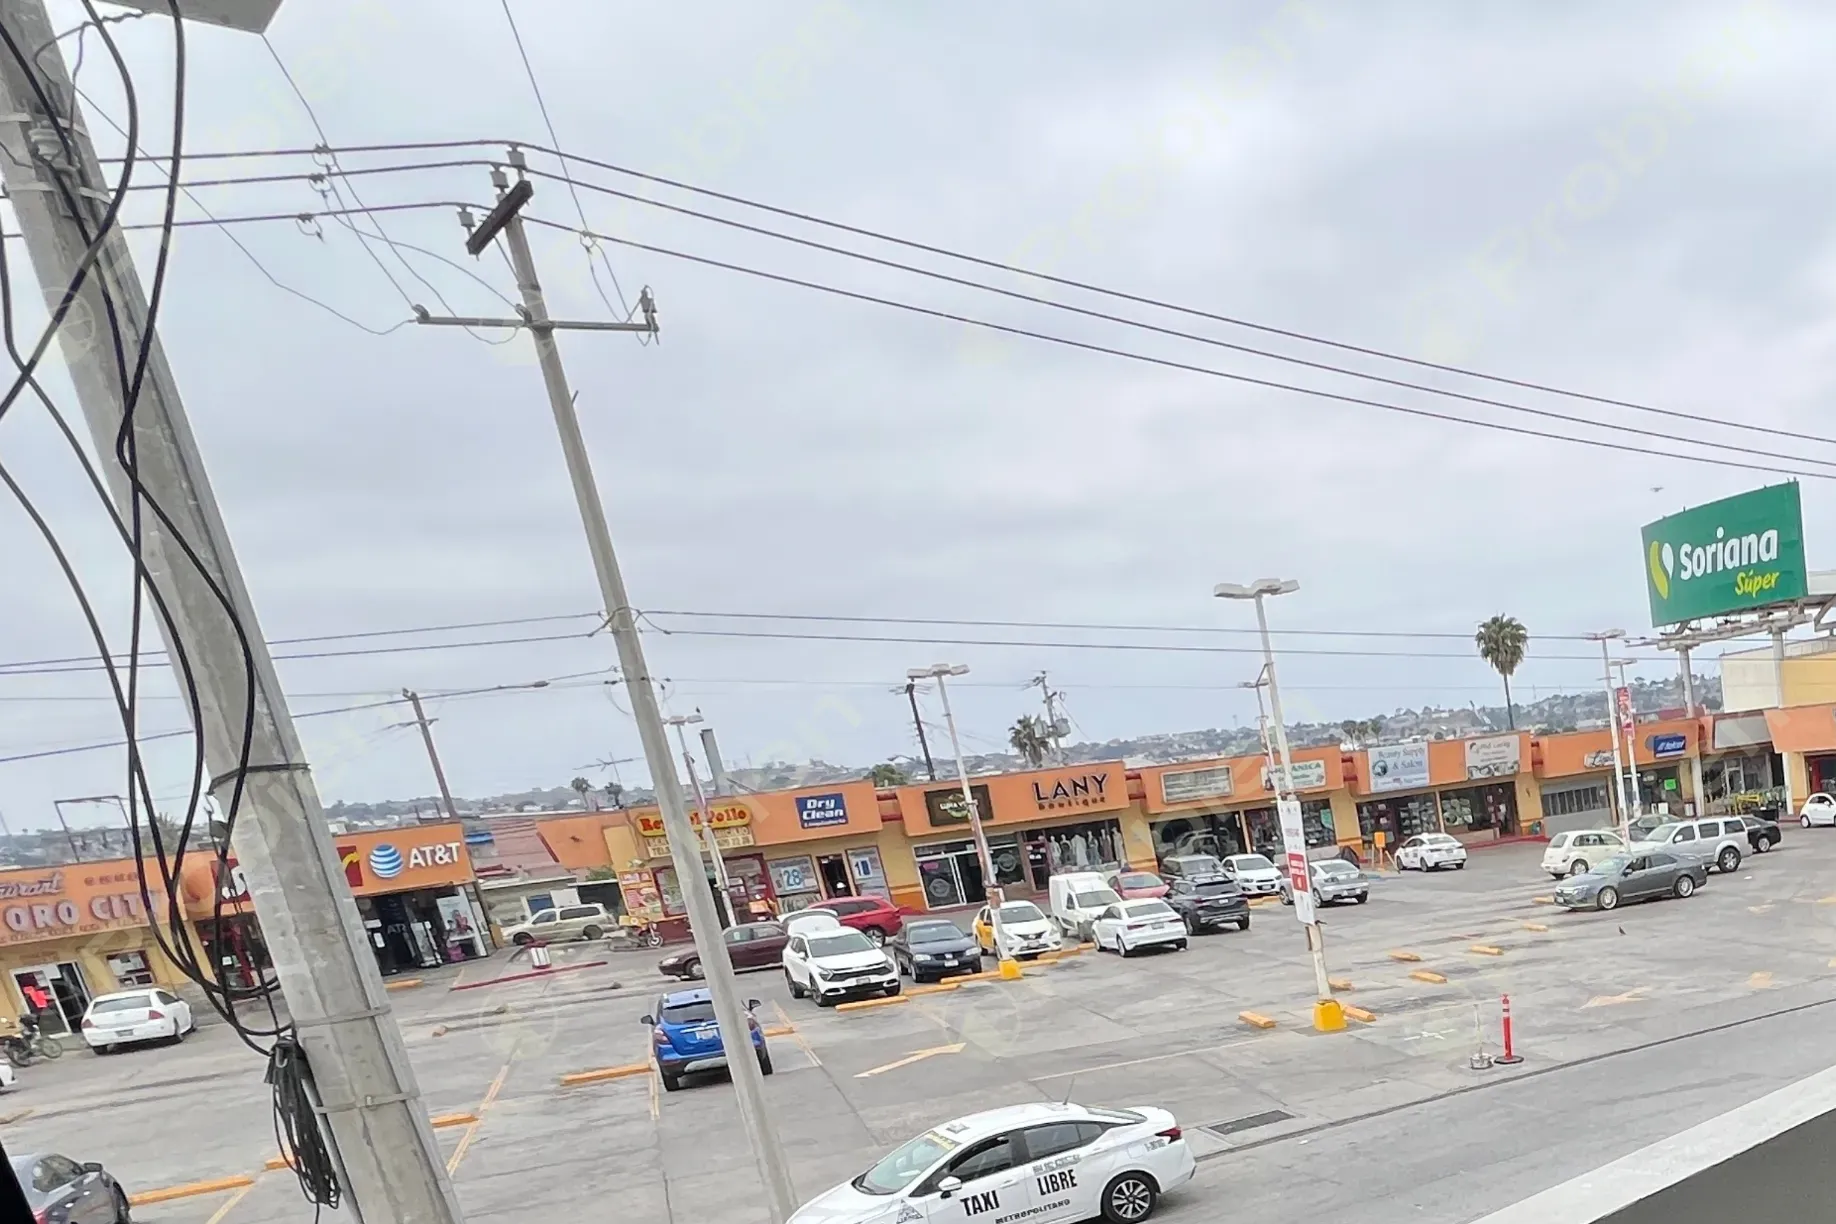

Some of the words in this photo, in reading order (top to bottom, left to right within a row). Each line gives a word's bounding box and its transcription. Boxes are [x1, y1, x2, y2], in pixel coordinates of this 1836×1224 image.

[1680, 527, 1778, 580] Soriana
[1735, 570, 1780, 598] Súper
[1032, 774, 1108, 802] LANY
[802, 809, 844, 821] Clean
[806, 799, 836, 810] Dry
[1037, 795, 1106, 811] boutique
[409, 841, 461, 869] AT&T
[783, 867, 801, 887] 28
[4, 898, 79, 932] ORO
[1036, 1169, 1078, 1196] LIBRE
[959, 1190, 1000, 1217] TAXI
